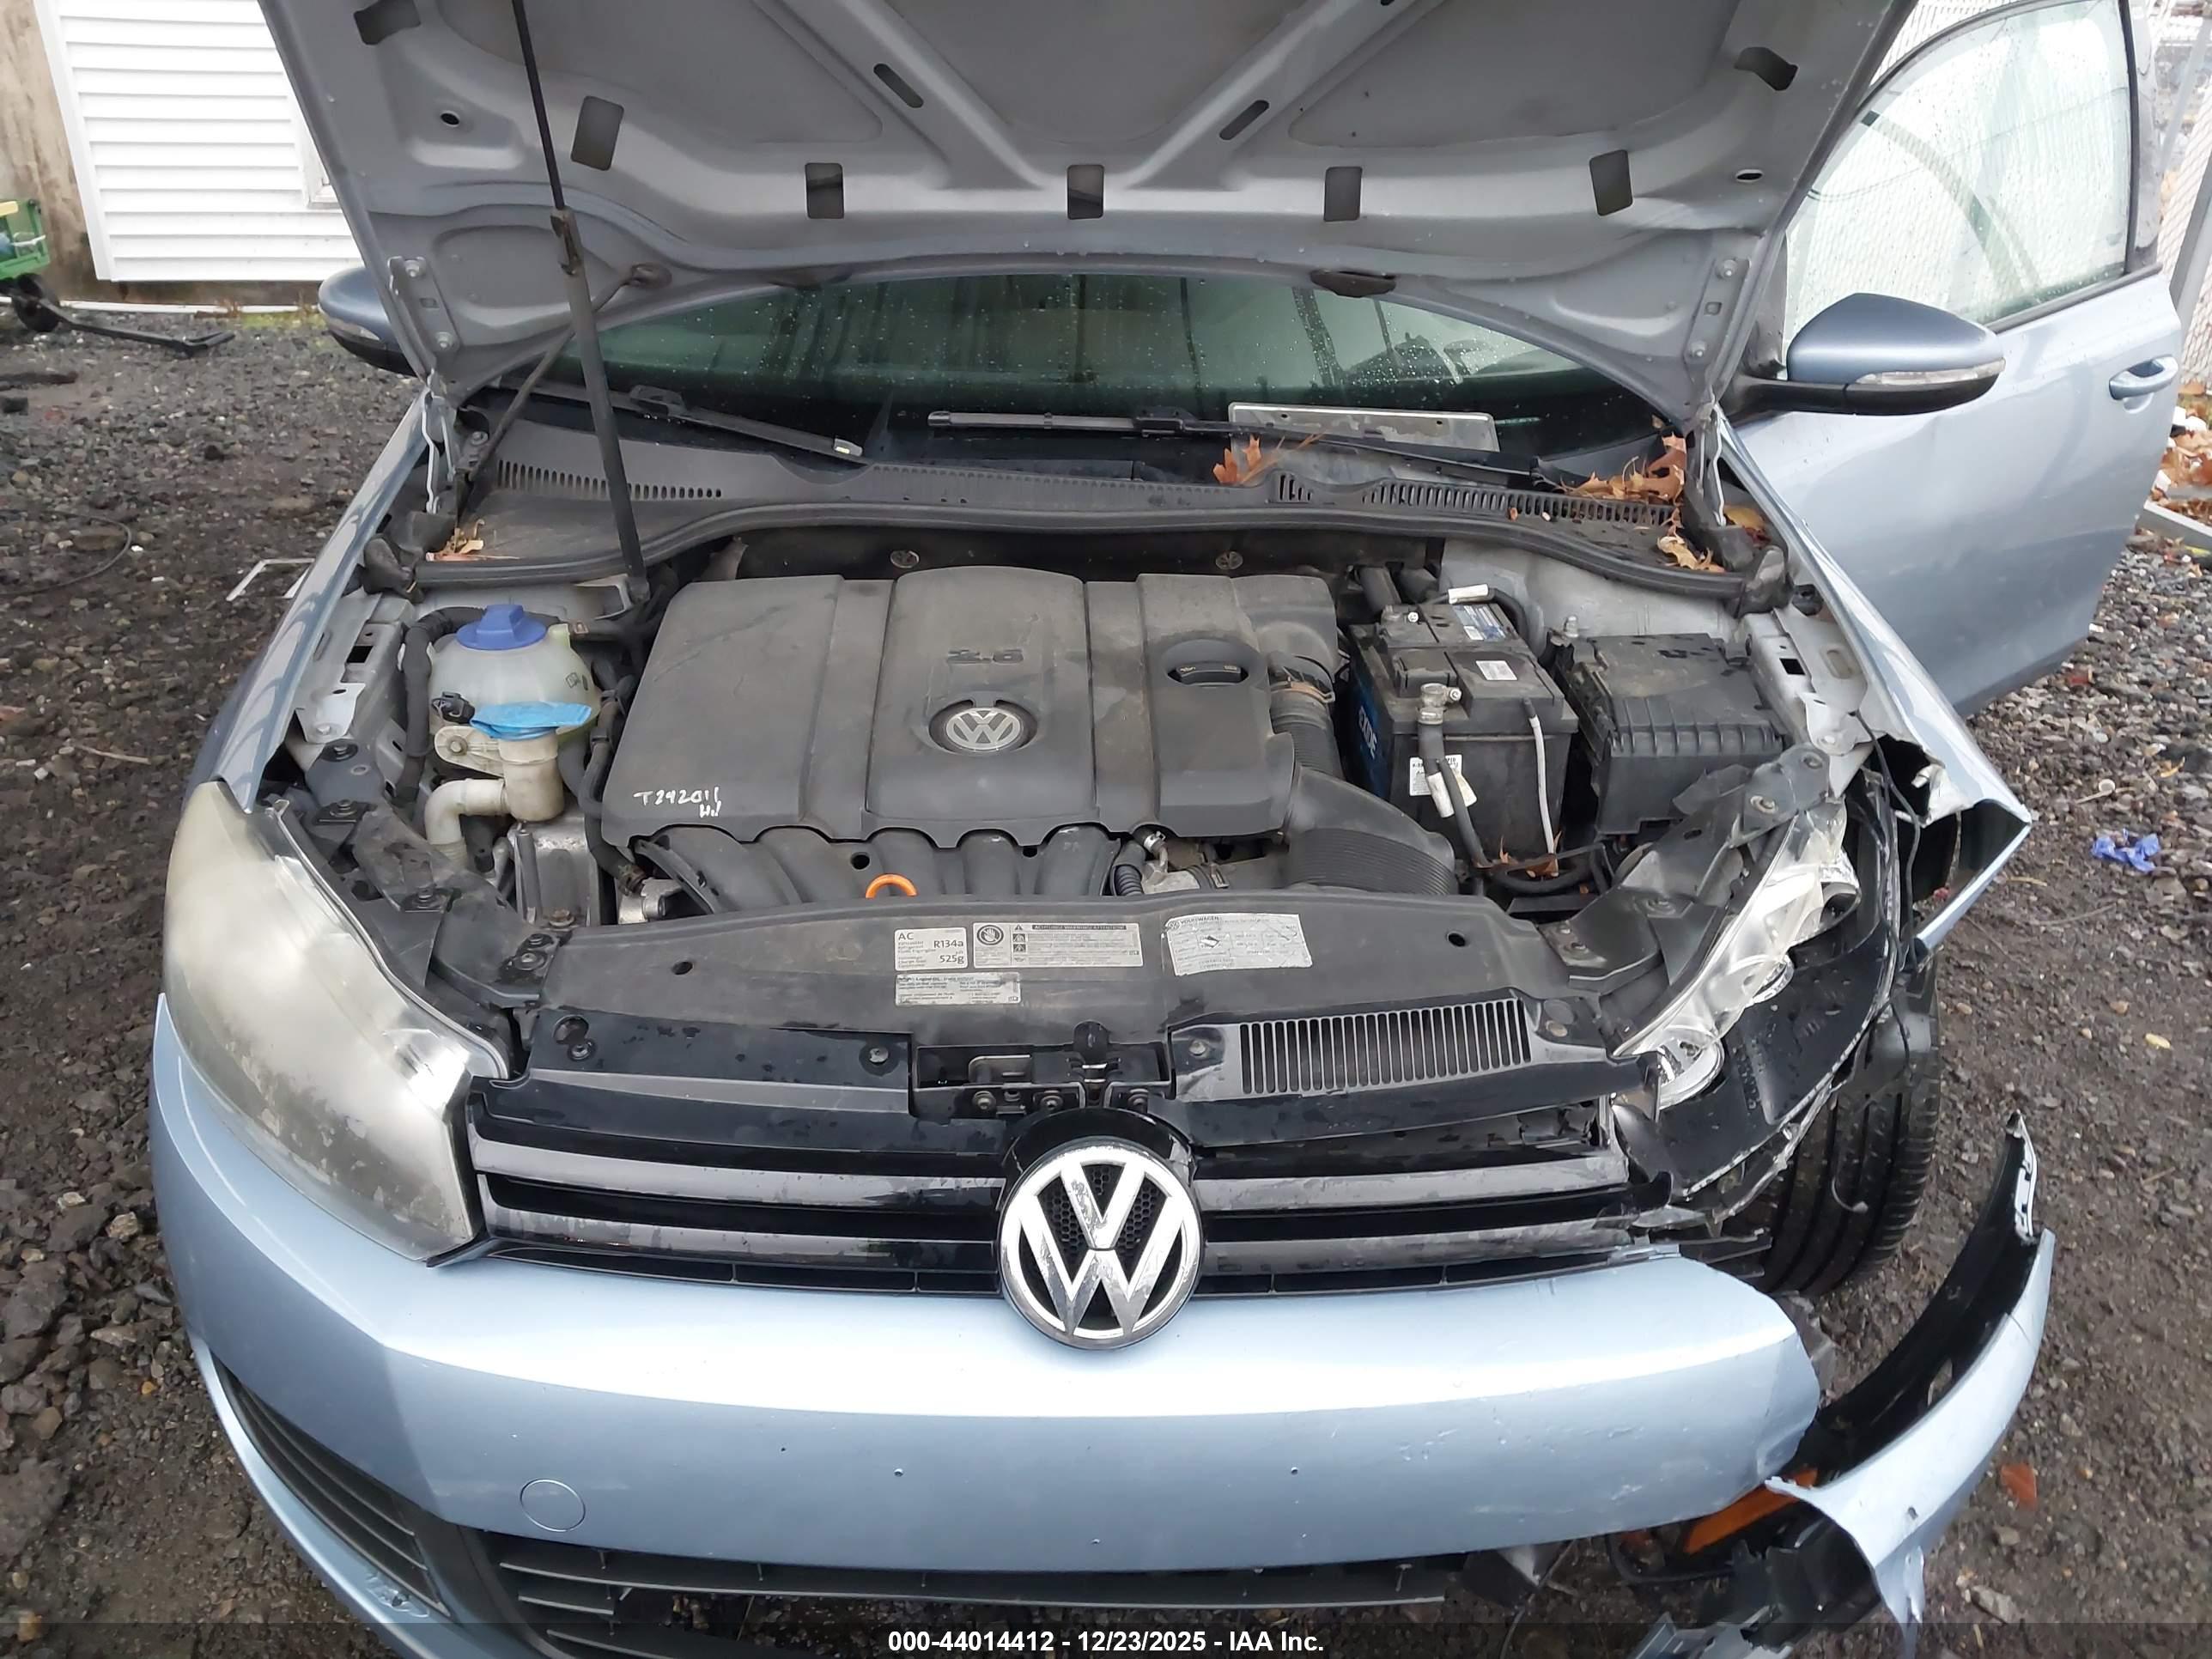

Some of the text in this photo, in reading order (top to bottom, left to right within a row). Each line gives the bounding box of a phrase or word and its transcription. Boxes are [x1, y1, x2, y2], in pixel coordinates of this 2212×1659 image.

[898, 932, 915, 940] AC
[933, 939, 964, 949] R134a
[939, 954, 964, 964] 525g
[997, 1135, 1205, 1351] VW
